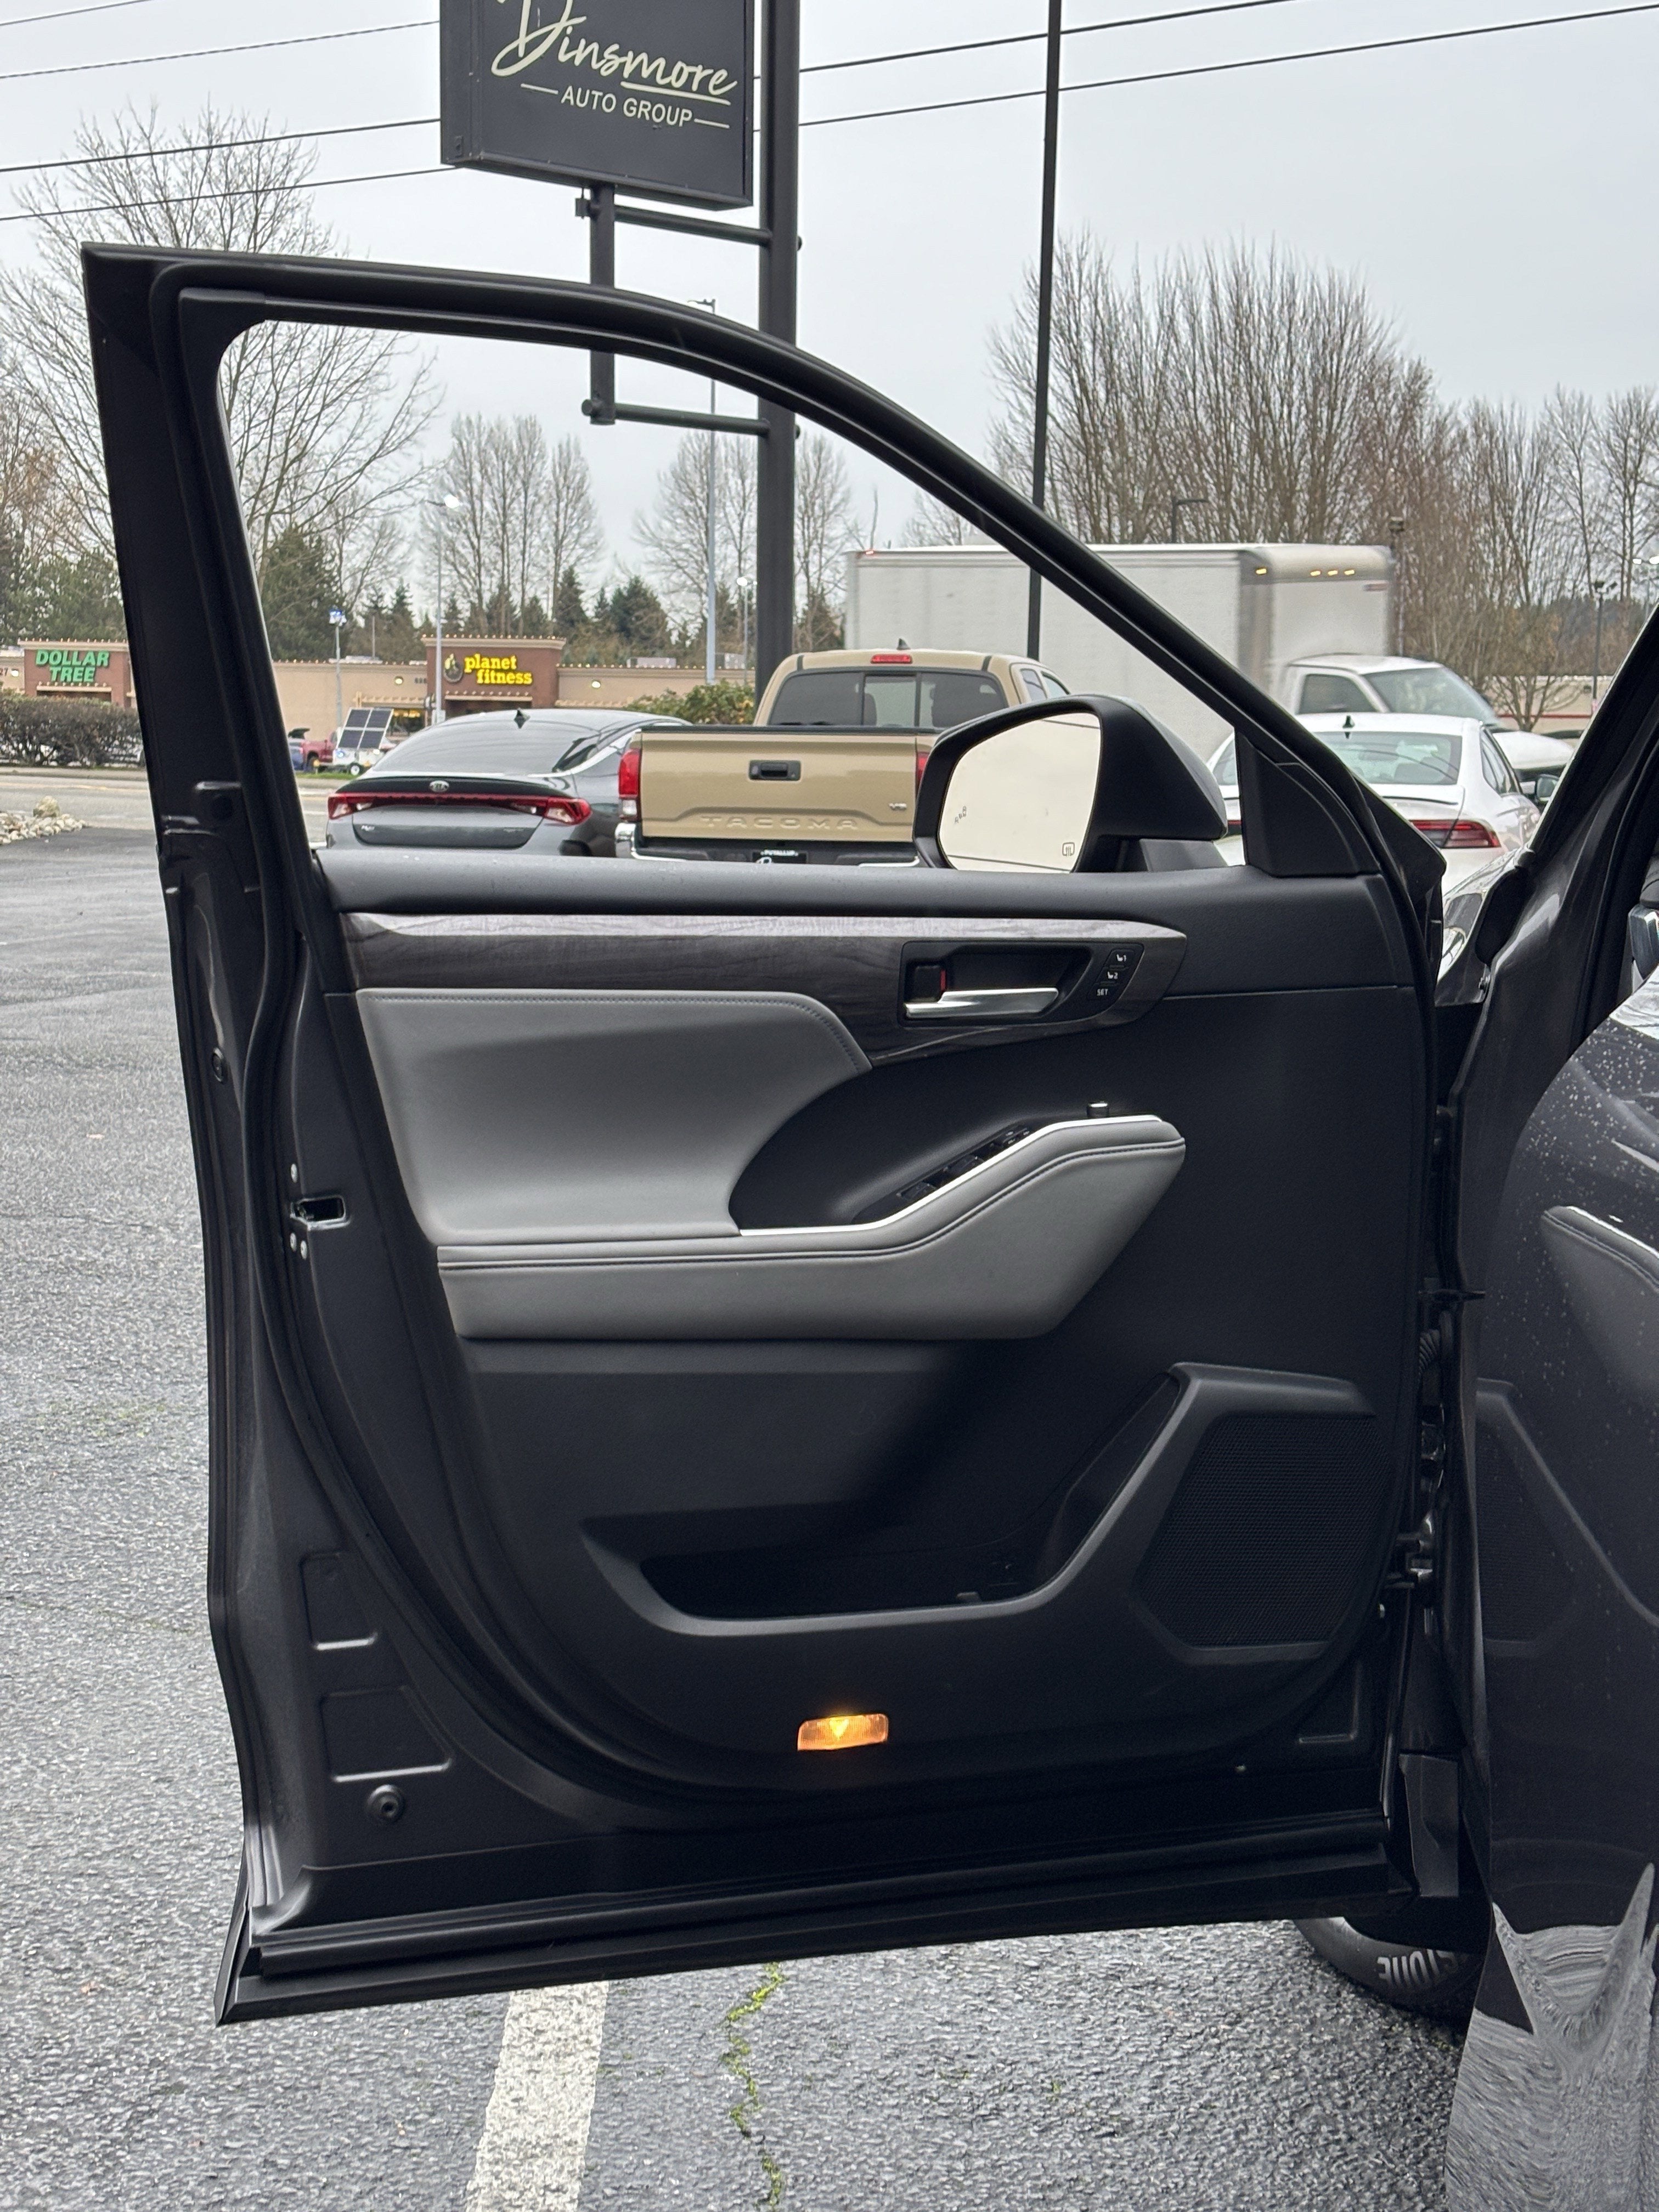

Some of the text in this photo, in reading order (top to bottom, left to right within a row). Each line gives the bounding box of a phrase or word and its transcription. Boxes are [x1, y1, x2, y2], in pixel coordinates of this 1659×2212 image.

[492, 0, 738, 95] Dinsmore
[561, 86, 692, 127] AUTO GROUP
[36, 648, 110, 667] DOLLAR
[464, 653, 517, 673] planet
[49, 666, 95, 682] TREE
[477, 669, 533, 685] fitness
[701, 815, 860, 831] TACOMA
[1096, 988, 1108, 996] SET
